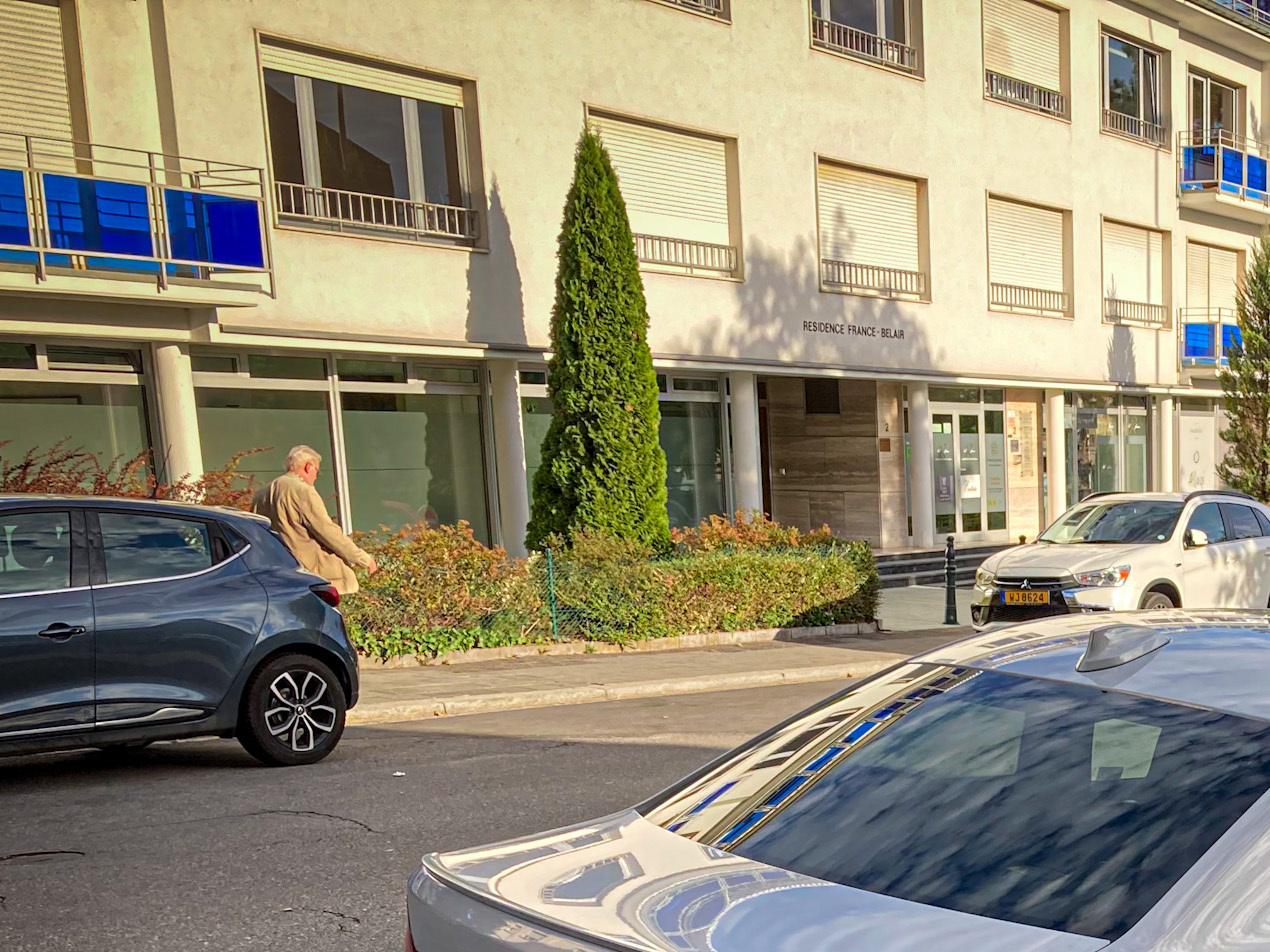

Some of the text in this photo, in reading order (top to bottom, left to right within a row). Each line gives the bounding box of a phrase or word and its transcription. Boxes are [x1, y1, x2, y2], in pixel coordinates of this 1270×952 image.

[803, 320, 845, 335] RESIDENCE
[885, 422, 889, 432] 2
[1012, 426, 1017, 434] 2
